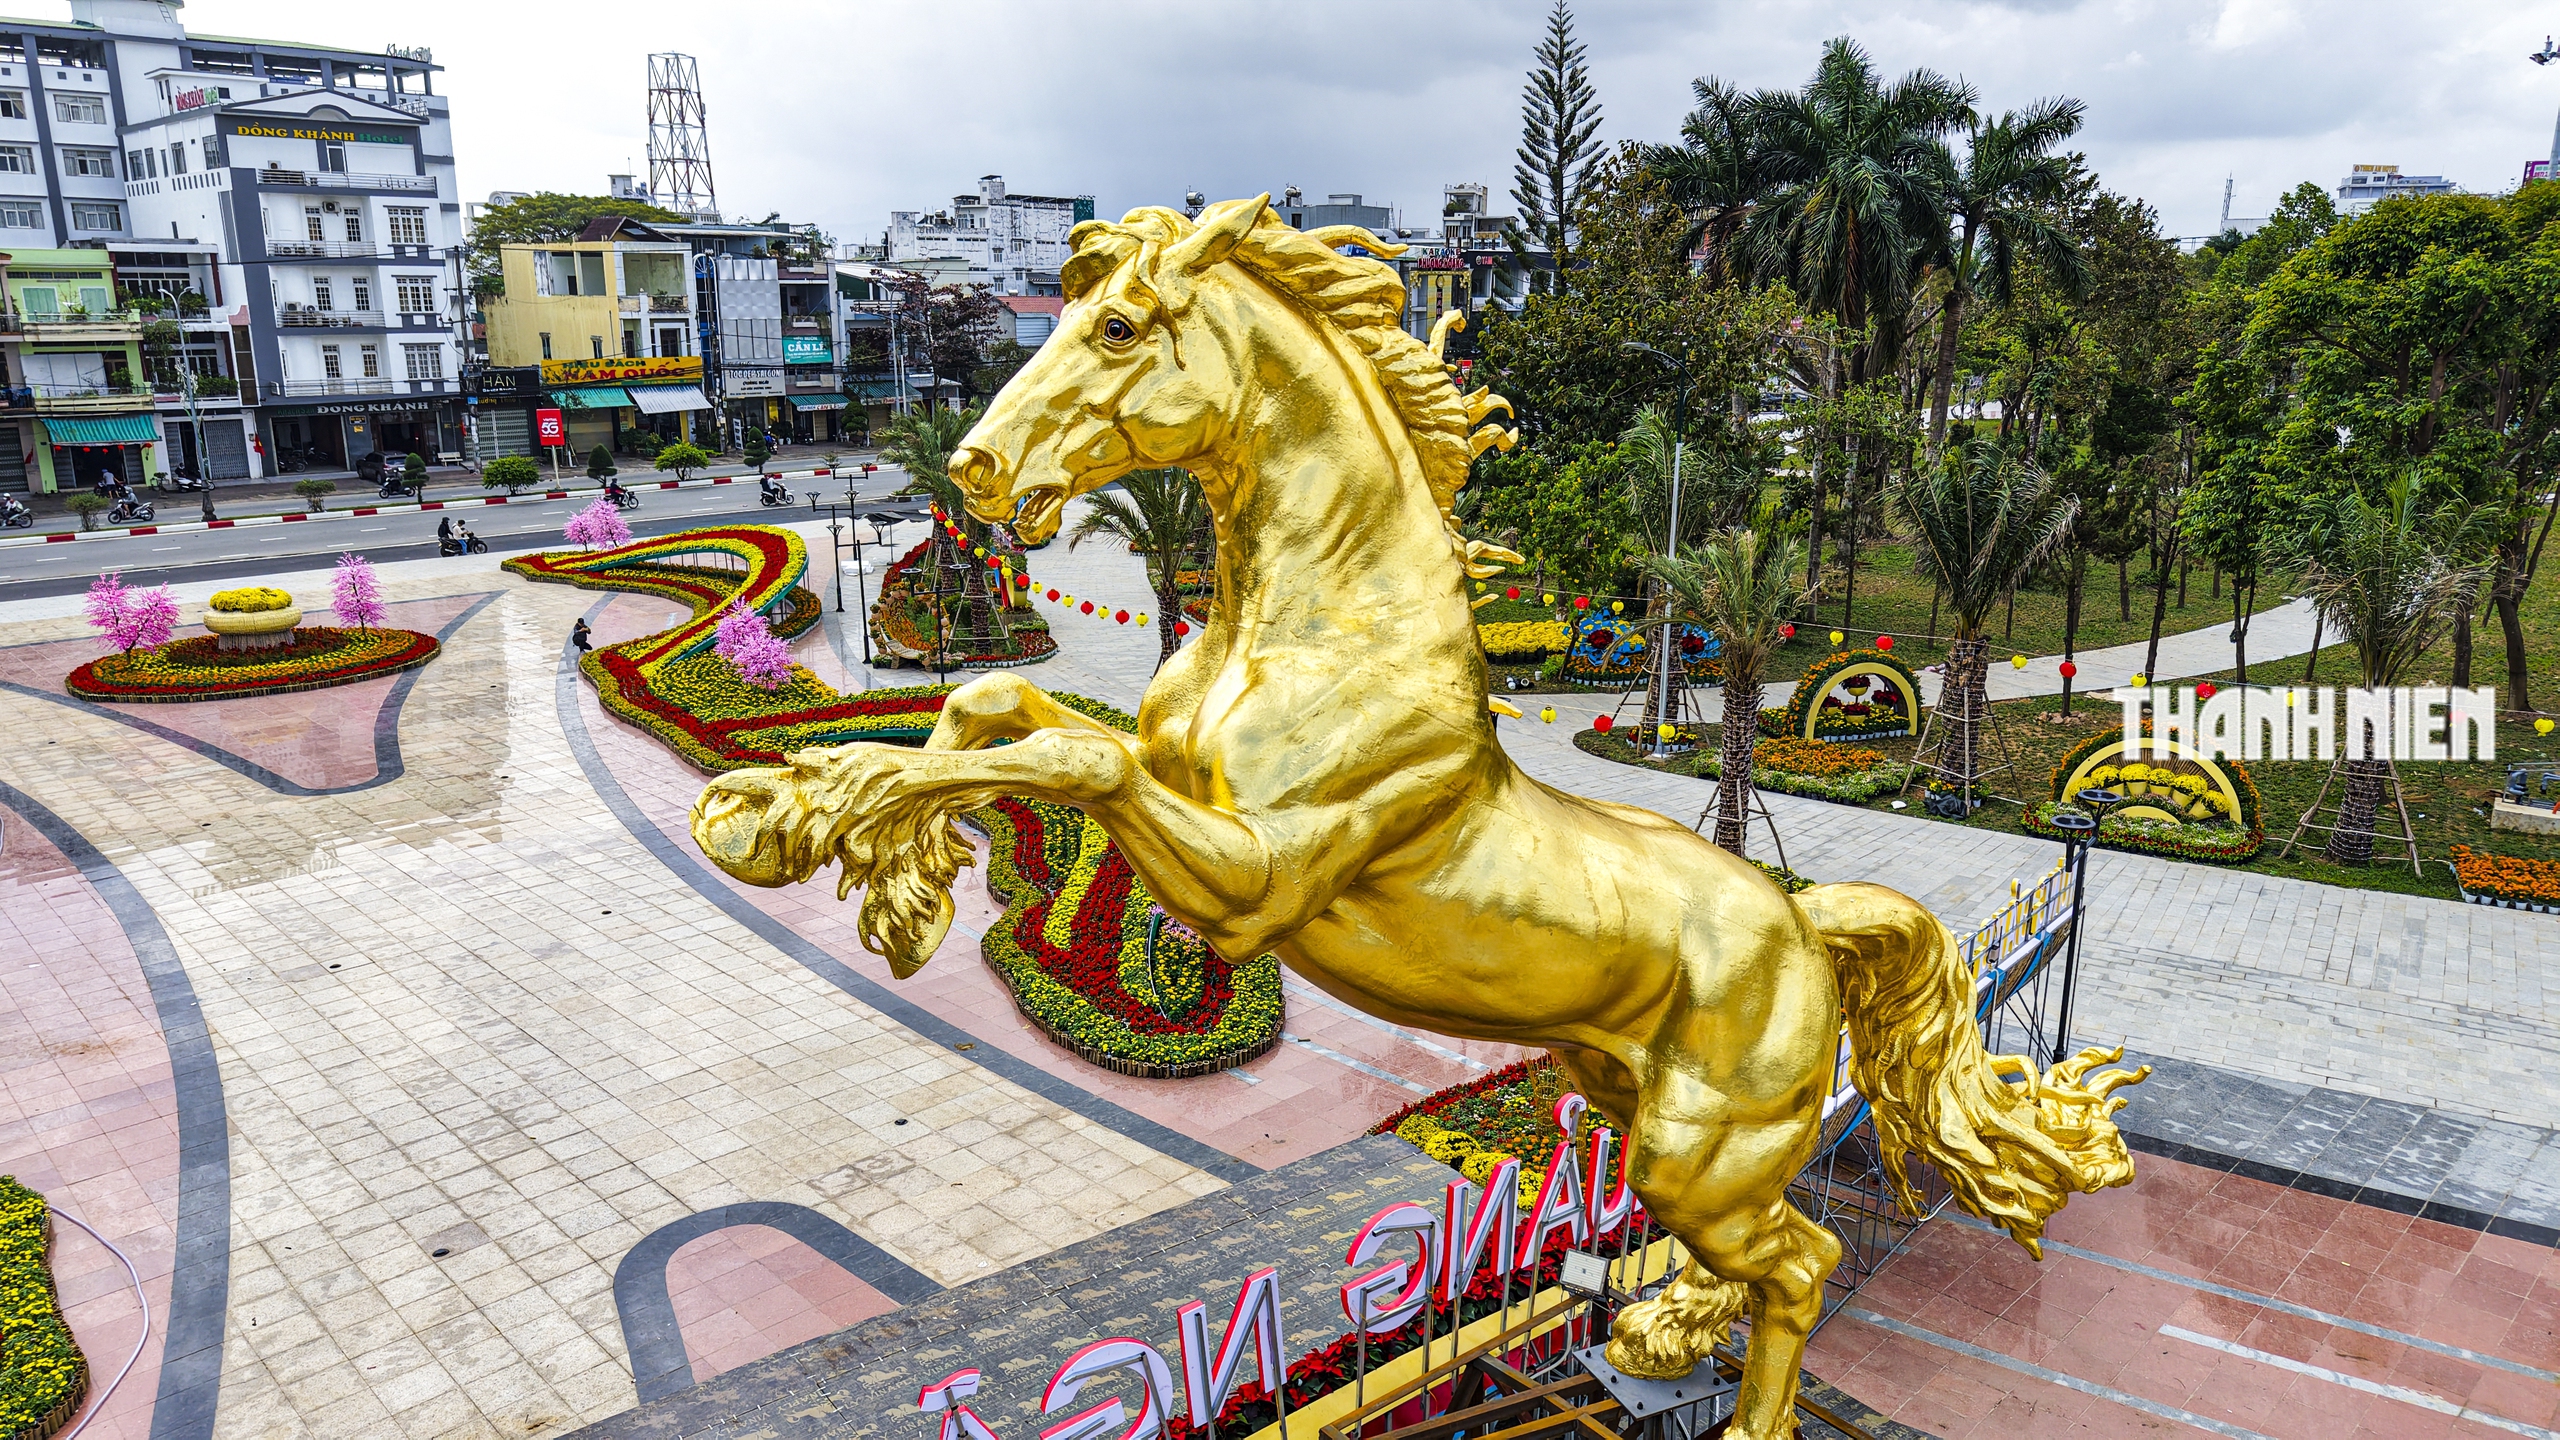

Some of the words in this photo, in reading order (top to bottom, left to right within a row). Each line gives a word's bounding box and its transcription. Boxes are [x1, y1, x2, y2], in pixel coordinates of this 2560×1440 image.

[237, 121, 288, 138] ĐỒNG
[293, 127, 355, 142] KHÁNH
[360, 133, 403, 143] Hotel
[1422, 247, 1461, 256] KARAOKE
[541, 422, 559, 434] 5G
[923, 1352, 973, 1378] VINAPLY
